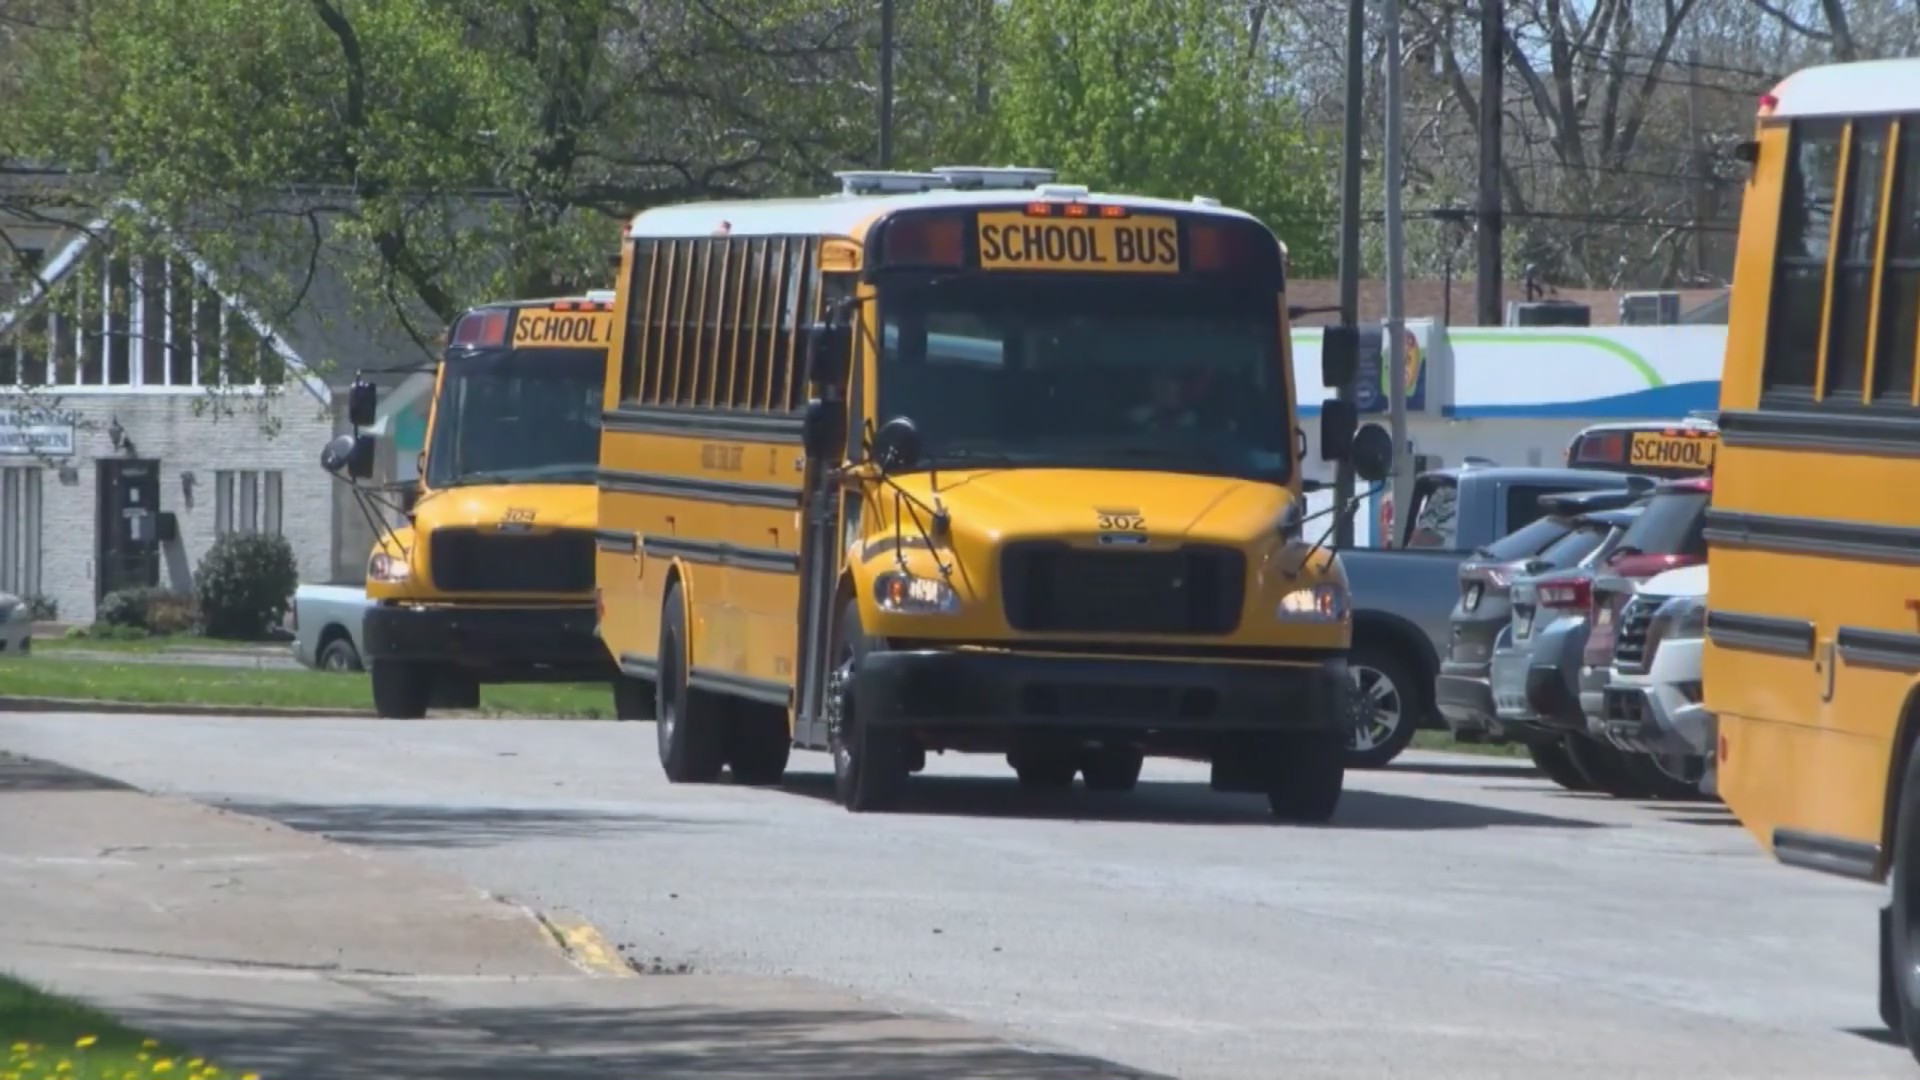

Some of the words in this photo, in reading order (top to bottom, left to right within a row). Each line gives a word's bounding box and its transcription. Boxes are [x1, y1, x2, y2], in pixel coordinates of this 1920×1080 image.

[981, 224, 1107, 262] SCHOOL
[1114, 226, 1177, 264] BUS
[516, 316, 598, 342] SCHOOL
[1633, 438, 1705, 466] SCHOOL
[1097, 514, 1148, 530] 302
